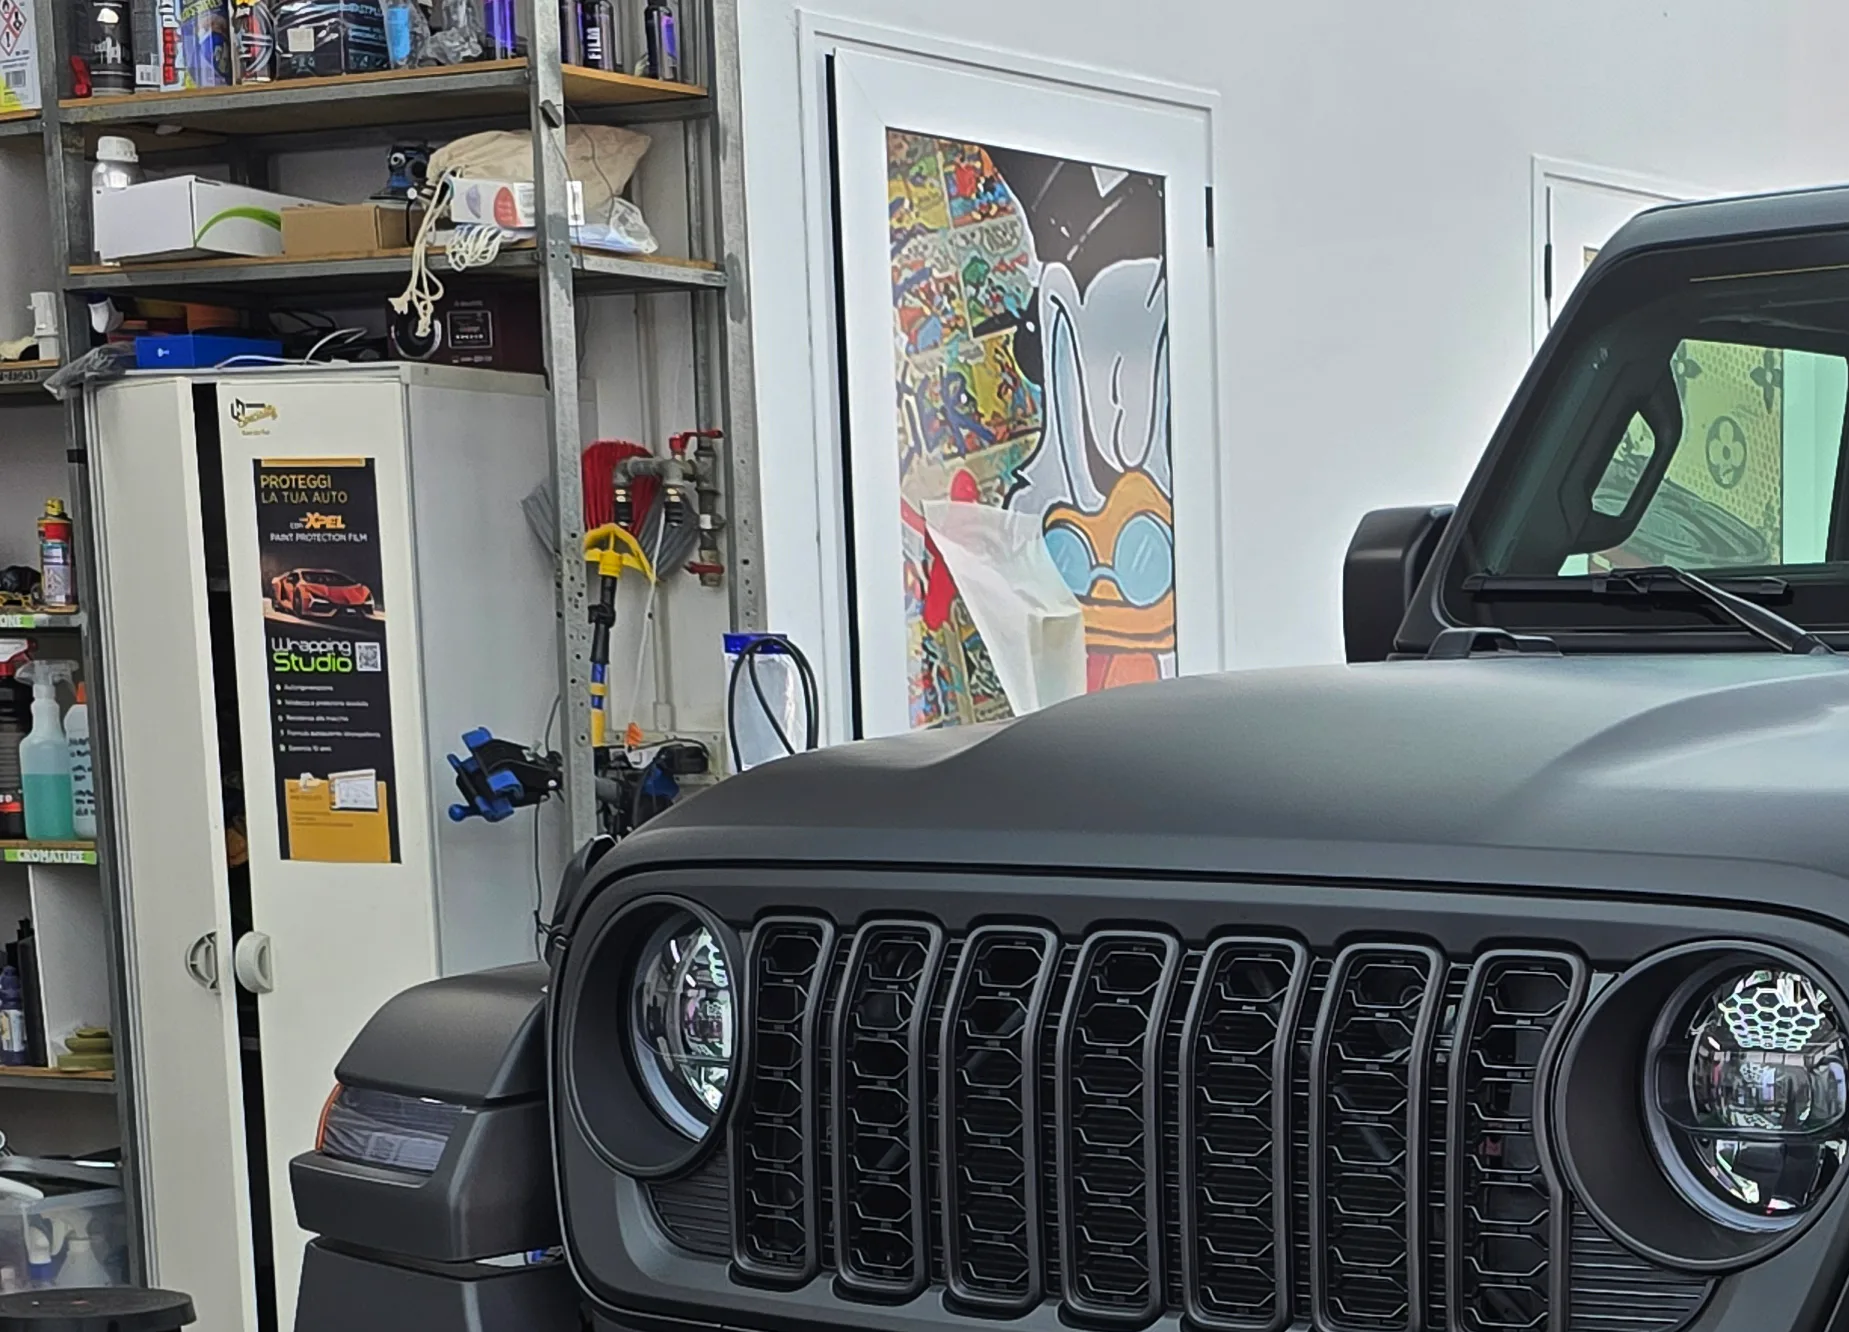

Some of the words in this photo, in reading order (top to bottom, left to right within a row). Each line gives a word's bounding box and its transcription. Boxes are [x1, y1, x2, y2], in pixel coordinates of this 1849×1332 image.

[586, 27, 602, 60] FILM
[260, 475, 332, 489] PROTEGGI
[261, 491, 279, 504] LA
[282, 491, 309, 504] TUA
[312, 491, 348, 504] AUTO
[299, 512, 346, 529] XPEL
[269, 532, 294, 542] PAINT
[296, 532, 346, 542] PROTECTION
[348, 532, 368, 542] FILM
[271, 637, 352, 656] Wrapping
[272, 652, 353, 672] Studio
[17, 848, 85, 863] CROMATURE
